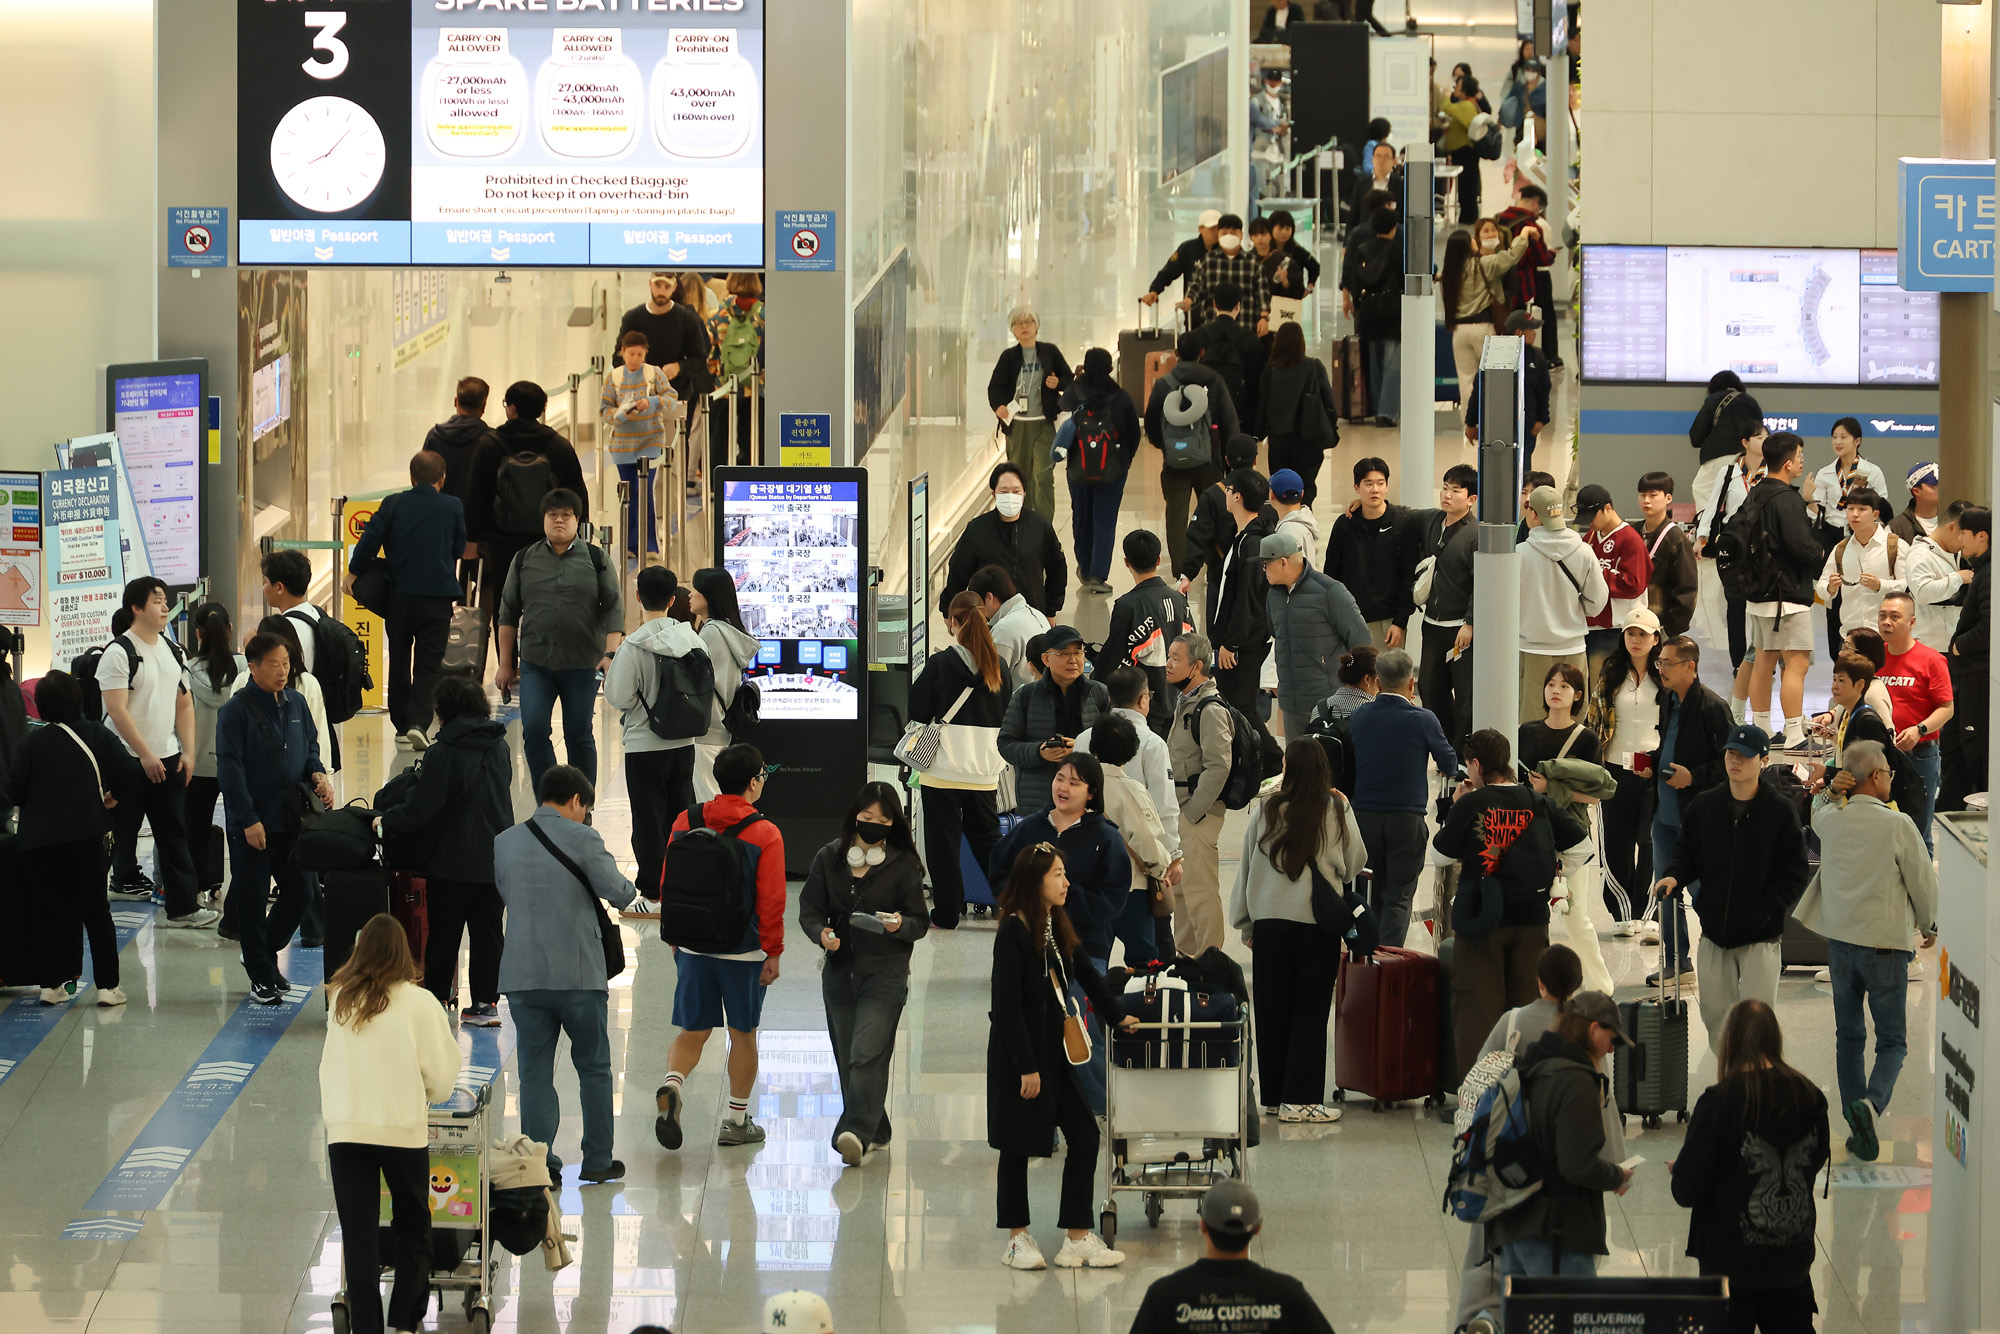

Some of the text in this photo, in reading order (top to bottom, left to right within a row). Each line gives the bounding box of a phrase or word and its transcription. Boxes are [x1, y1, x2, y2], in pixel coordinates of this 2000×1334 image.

[447, 34, 501, 42] CARRY-ON
[302, 11, 350, 80] 3
[440, 76, 506, 86] ~27,000mAh
[470, 86, 492, 94] less
[558, 84, 619, 93] 27,000mAh
[670, 88, 735, 98] 43,000mAh
[563, 95, 625, 104] 43,000mAh
[450, 109, 498, 117] allowed
[673, 113, 735, 121] (160Wh over)
[486, 174, 689, 188] Prohibited in Checked Baggage
[485, 188, 689, 201] Do not keep it on overhead-bin
[532, 206, 583, 215] prevention
[585, 207, 619, 216] (Taping
[632, 207, 665, 216] storing
[678, 207, 708, 216] plastic
[710, 207, 735, 216] bags)
[784, 214, 827, 222] 사진촬영금지
[270, 228, 379, 244] 일반여권 Passport
[498, 230, 556, 244] Passport
[676, 231, 733, 246] Passport
[1933, 239, 1995, 259] CART
[52, 476, 109, 496] 외국환신고
[750, 484, 832, 494] 출국장별 대기열 상황
[52, 494, 110, 509] CURRENCY DECLARATION
[787, 504, 811, 512] 출국장
[787, 550, 811, 558] 출국장
[63, 571, 77, 581] over
[787, 594, 811, 603] 출국장
[61, 613, 79, 621] DECLARE
[87, 610, 107, 618] CUSTOMS
[1484, 810, 1532, 828] SUMMER
[1176, 1303, 1281, 1323] Deus CUSTOMS
[1573, 1313, 1645, 1325] DELIVERING
